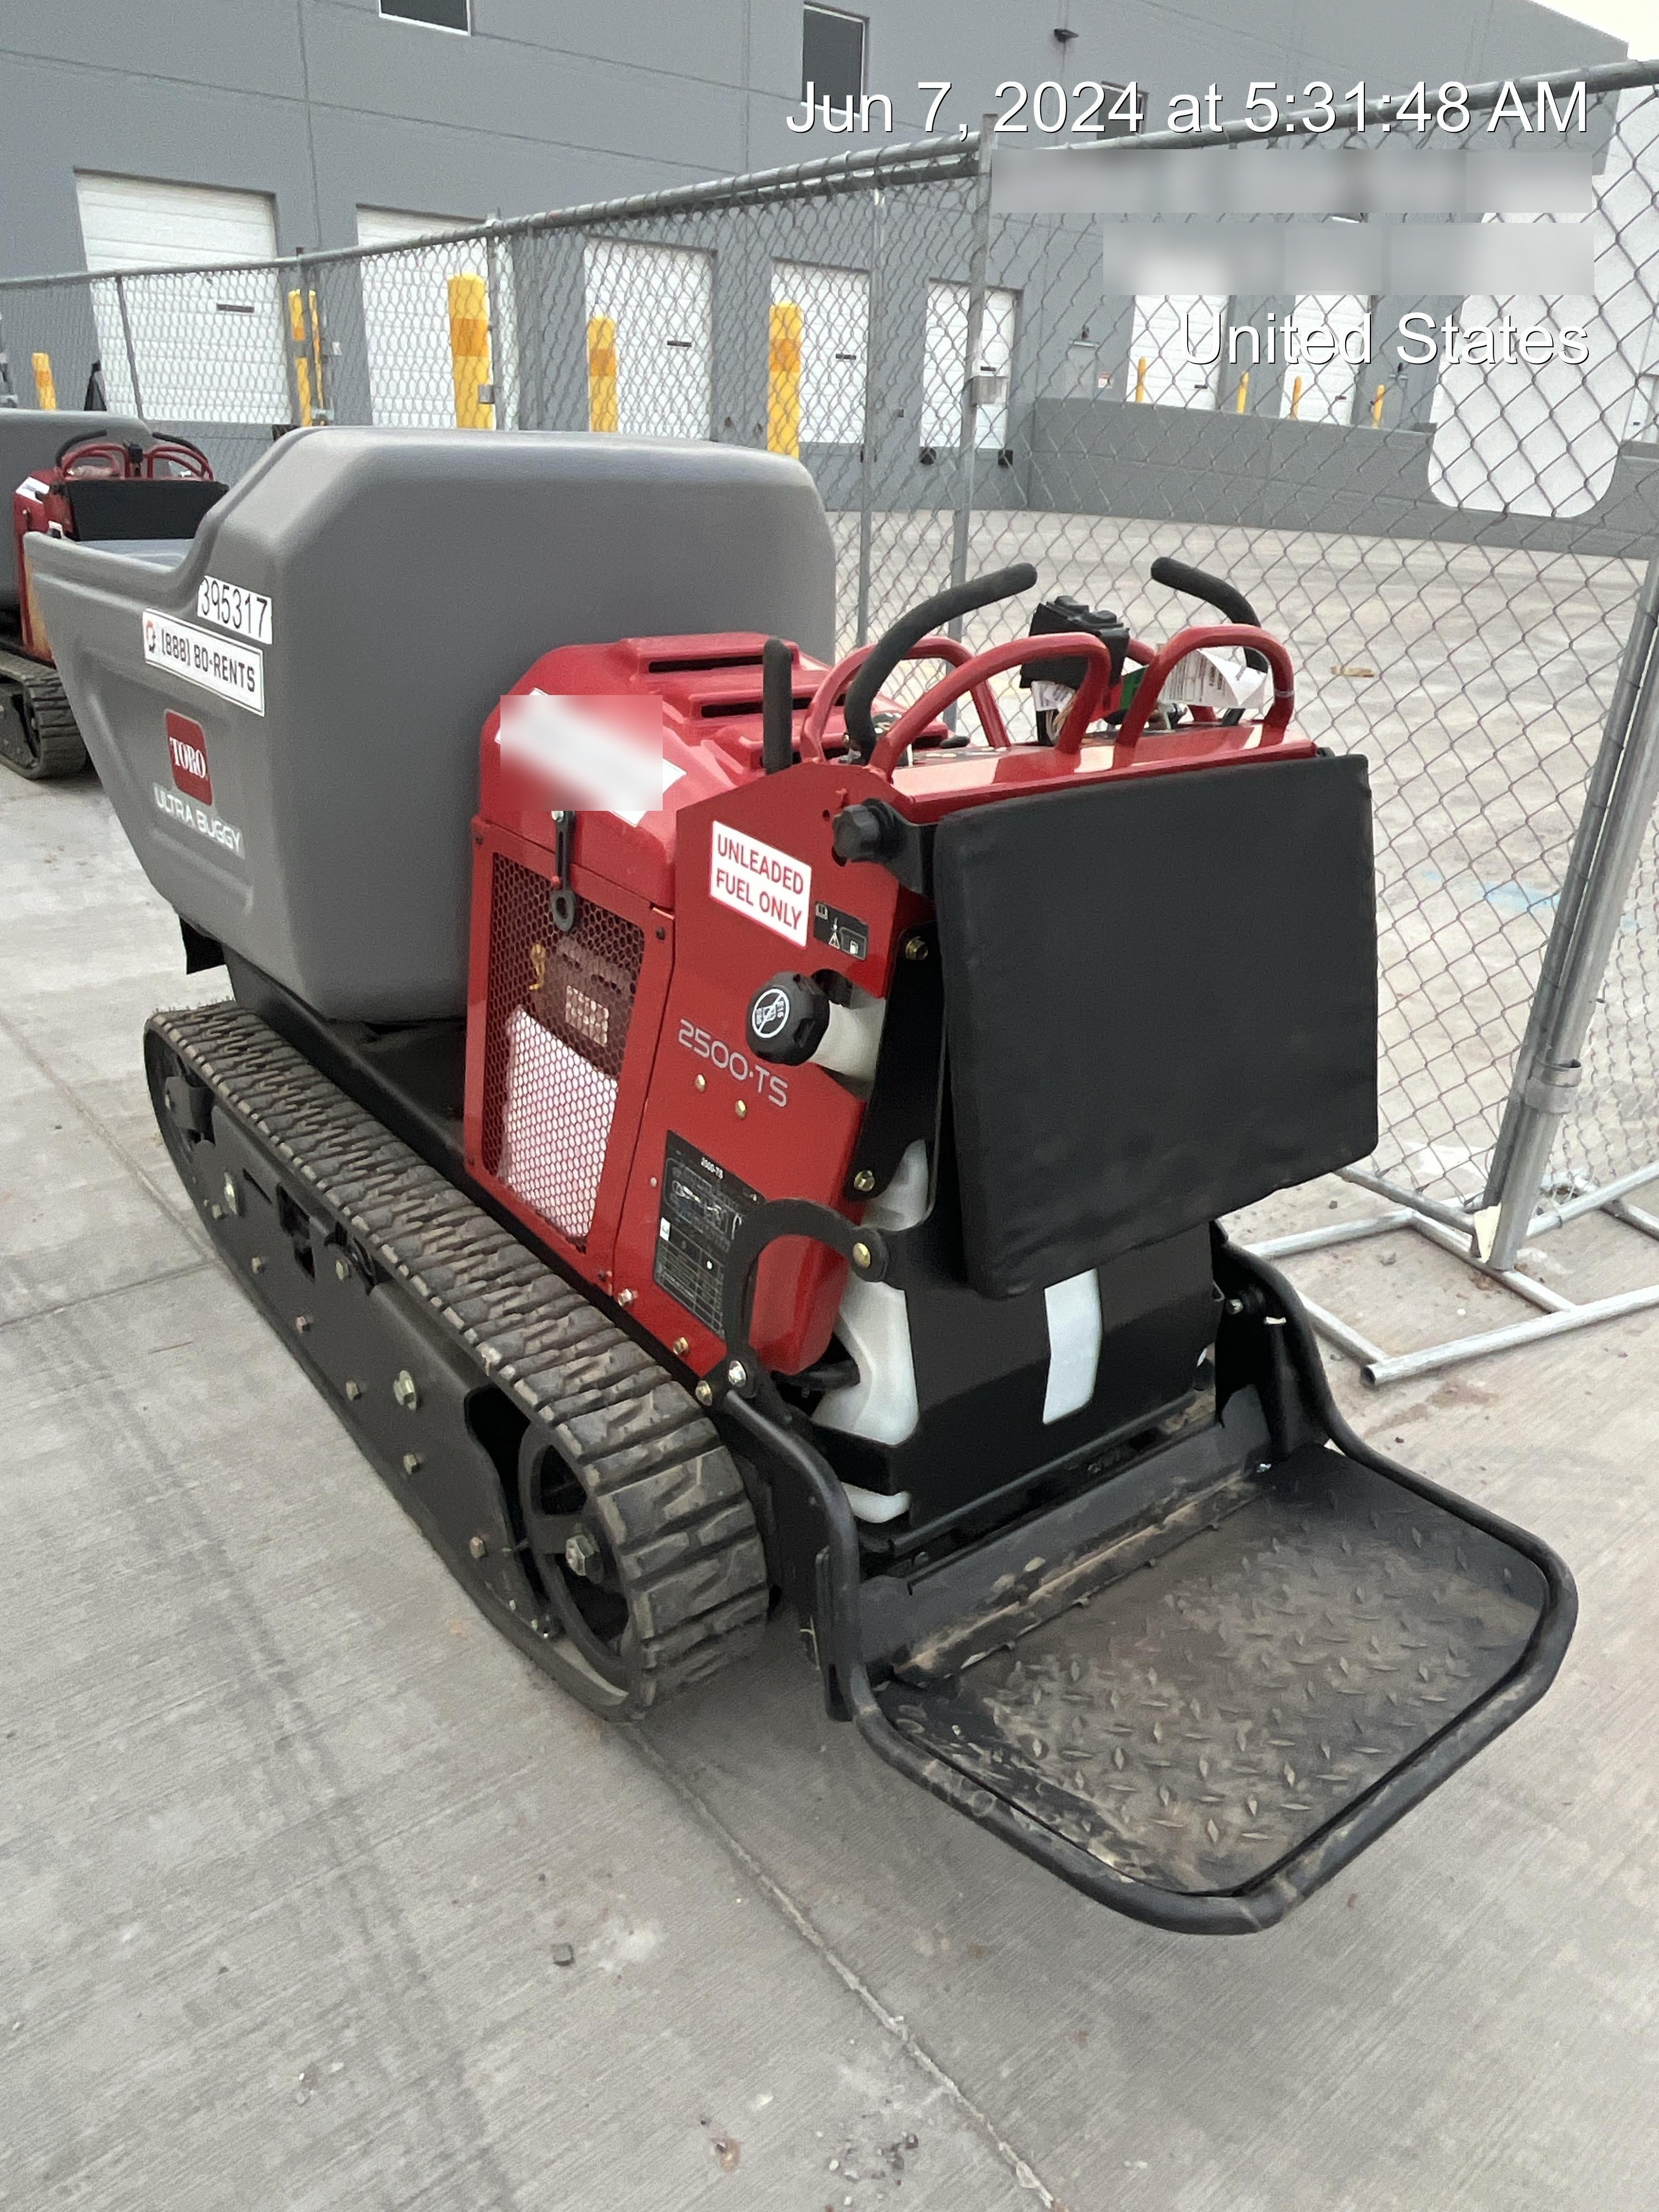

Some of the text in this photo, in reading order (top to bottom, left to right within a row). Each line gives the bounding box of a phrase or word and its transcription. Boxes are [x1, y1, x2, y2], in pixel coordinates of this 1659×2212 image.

[199, 578, 268, 638] 395317
[161, 628, 255, 692] (888) 80-RENTS
[168, 736, 206, 778] TORO
[154, 786, 240, 852] ULTRA BUGGY
[718, 833, 804, 895] UNLEADED
[716, 868, 803, 930] FUEL ONLY
